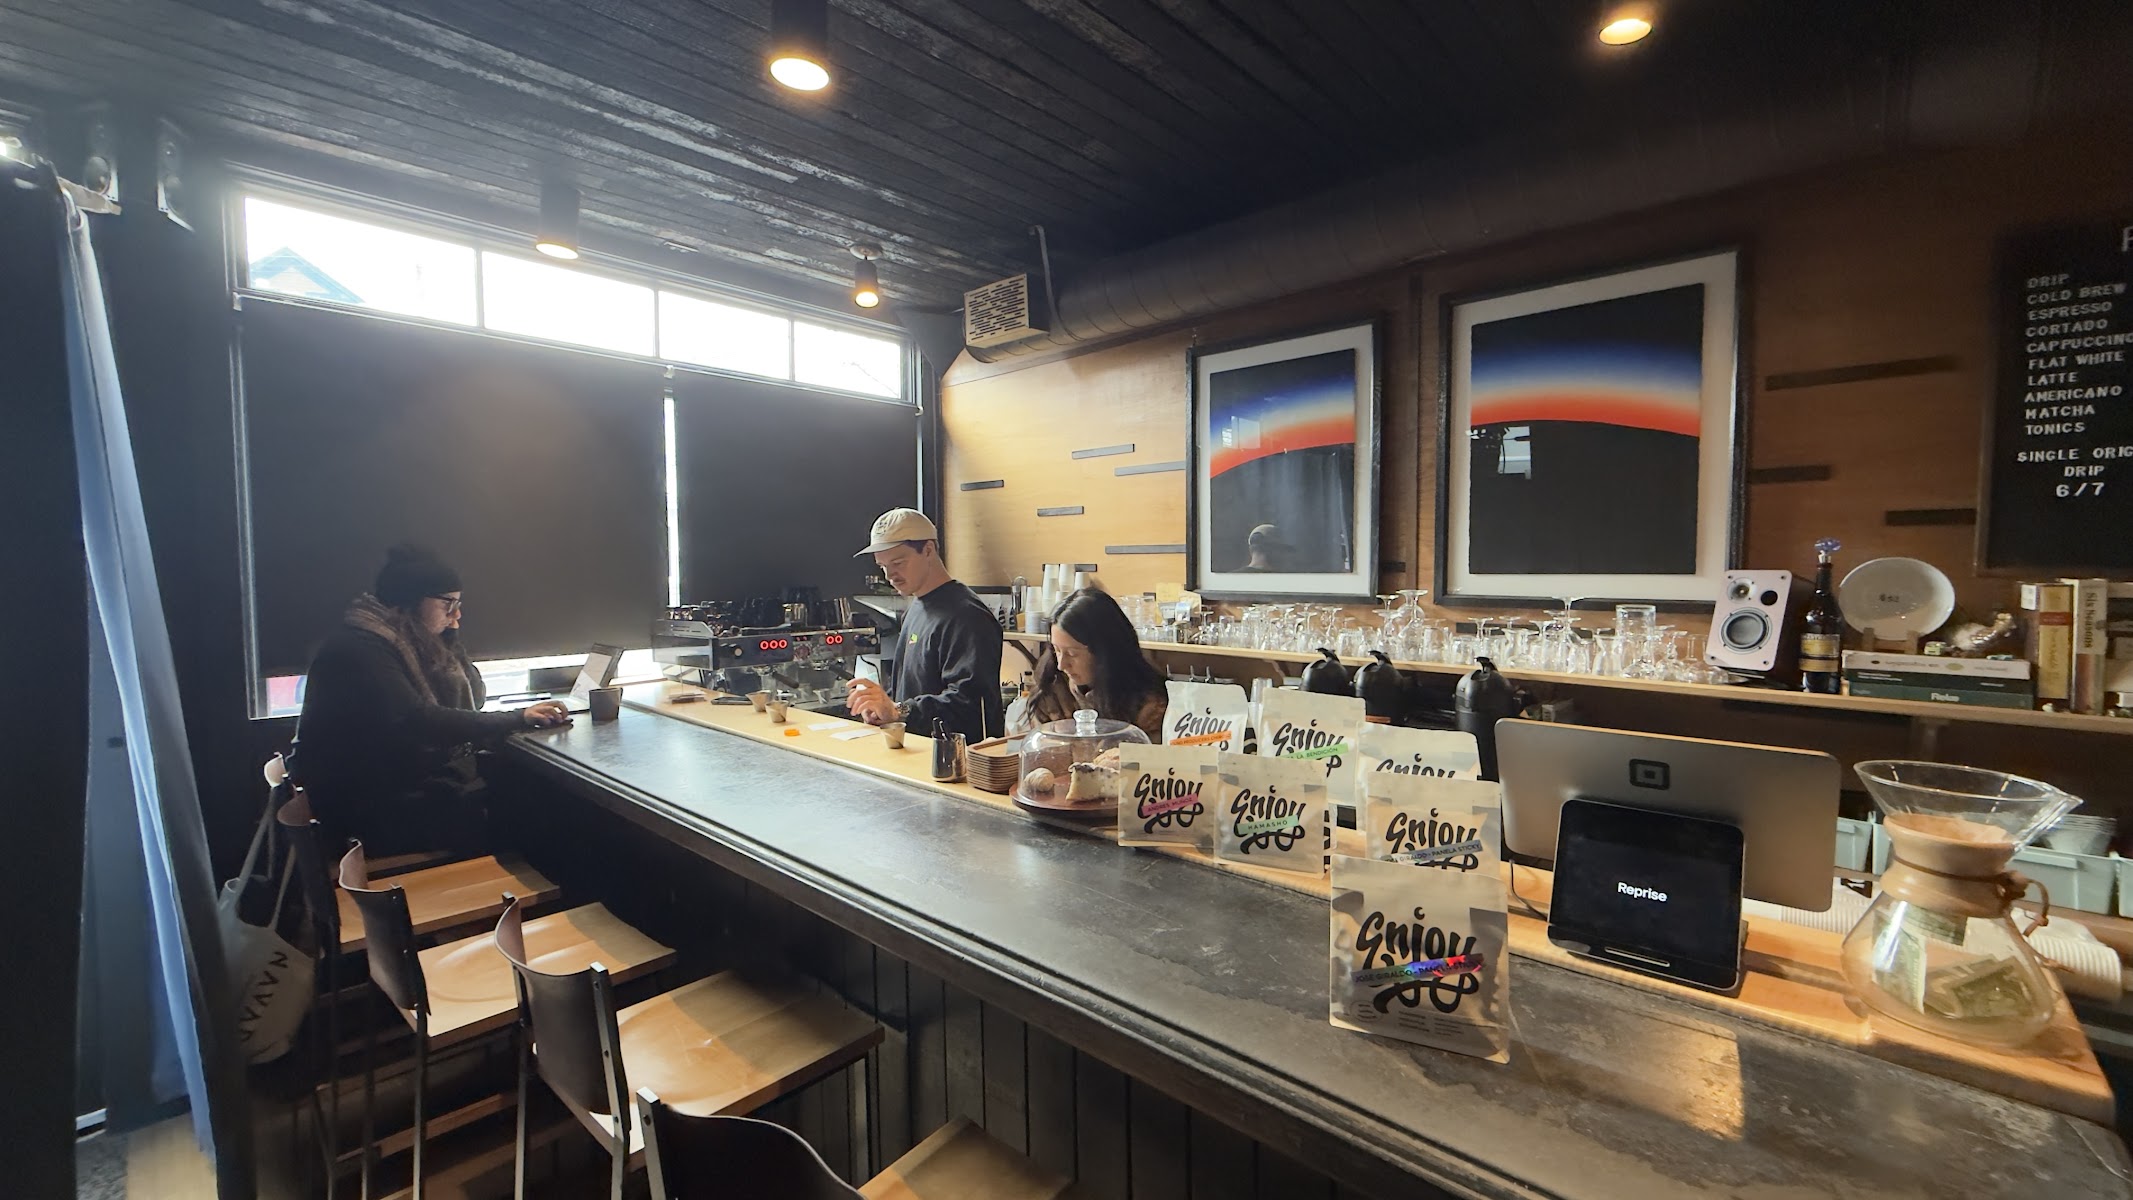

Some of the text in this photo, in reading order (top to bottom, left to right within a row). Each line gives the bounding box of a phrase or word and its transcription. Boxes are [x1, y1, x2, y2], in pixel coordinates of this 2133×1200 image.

[2027, 273, 2069, 288] DRIP
[2027, 282, 2127, 305] COLD BREW
[2028, 301, 2112, 321] ESPRESSO
[2025, 319, 2108, 337] CORTADO
[2028, 350, 2124, 370] FLAT WHITE
[2028, 372, 2078, 386] LATTE
[2024, 385, 2123, 403] AMERICANO
[2025, 404, 2095, 420] MATCHA
[2025, 421, 2085, 436] TONICS
[2017, 447, 2080, 463] SINGLE
[2063, 464, 2105, 478] DRIP
[1174, 706, 1233, 751] Enjoy
[1272, 719, 1344, 778] Enjoy
[1133, 767, 1204, 834] Enjoy
[1230, 785, 1306, 855] Enjoy
[1247, 819, 1288, 830] HAMASHO
[1385, 808, 1479, 872] Enjoy
[1431, 847, 1457, 857] PANELA
[1458, 843, 1480, 853] STICKY
[1617, 881, 1668, 903] Reprise
[1356, 907, 1479, 1013] Enjoy
